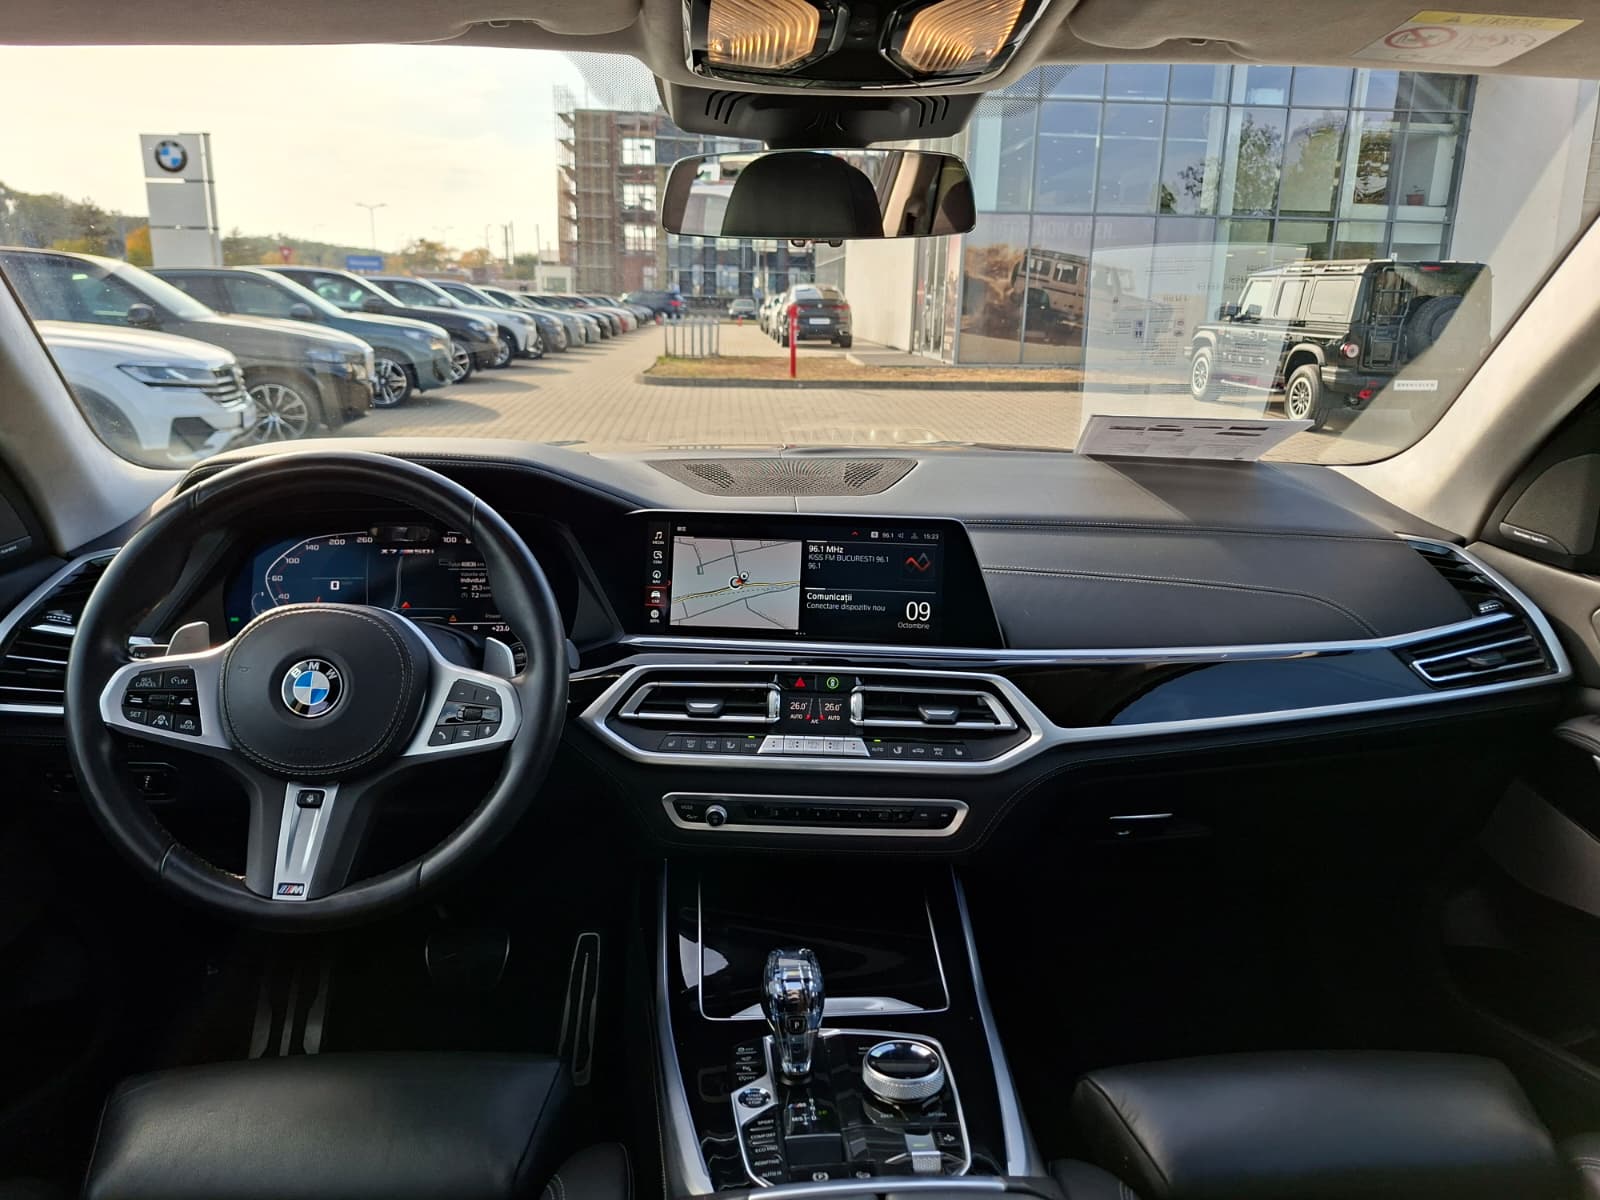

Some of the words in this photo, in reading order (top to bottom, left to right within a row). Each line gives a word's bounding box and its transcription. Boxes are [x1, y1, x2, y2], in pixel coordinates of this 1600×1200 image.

[328, 538, 346, 546] 200
[356, 536, 373, 544] 260
[808, 544, 824, 553] 96.1
[826, 545, 844, 554] MHz
[836, 554, 876, 563] BUCURESTI
[806, 602, 840, 610] Conectare
[841, 603, 872, 612] dispozitiv
[905, 600, 932, 622] 09
[897, 621, 930, 630] Octombrie
[290, 661, 338, 681] BMW
